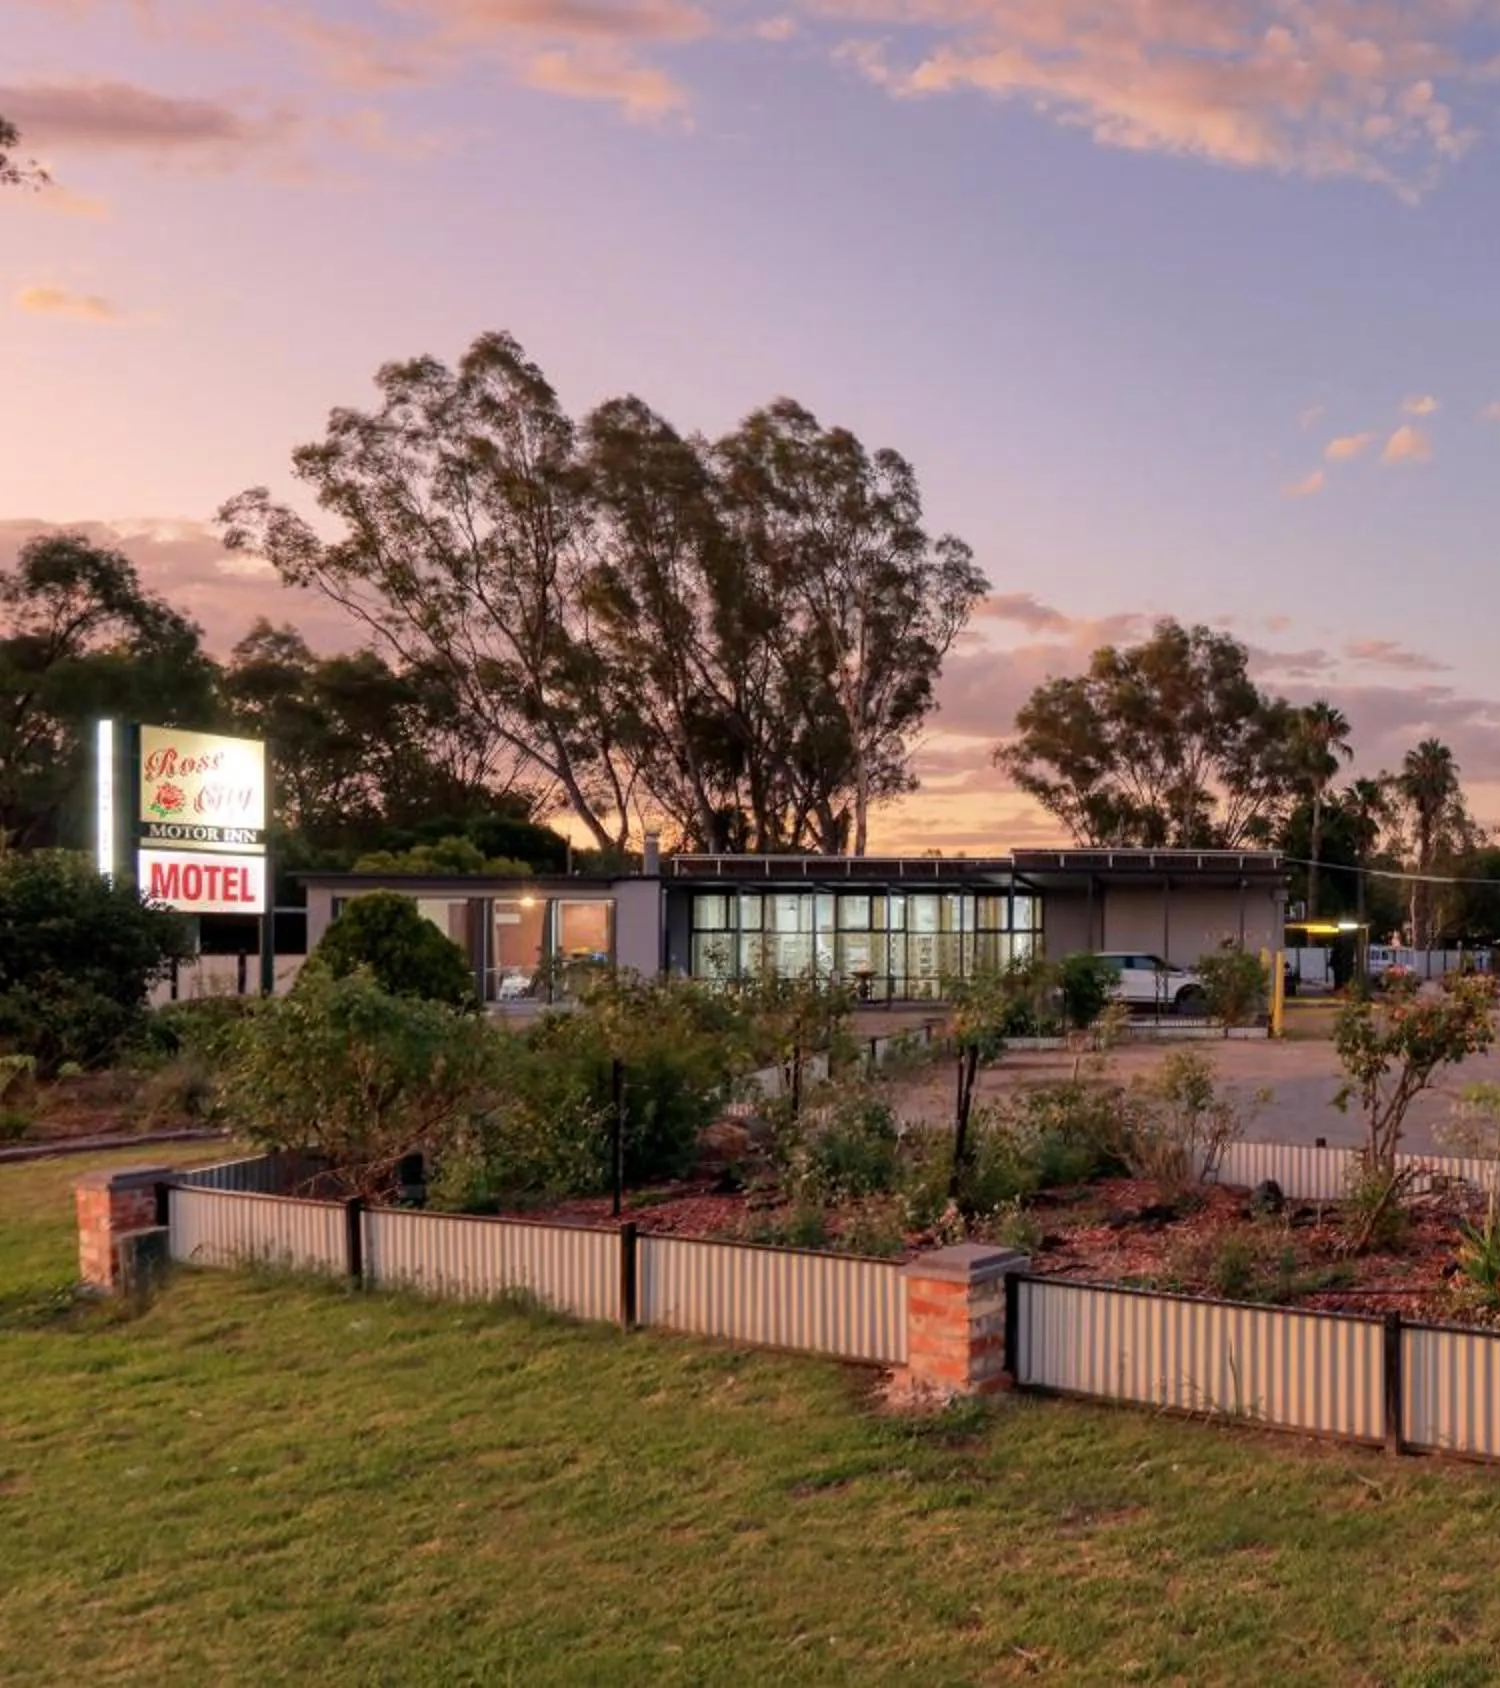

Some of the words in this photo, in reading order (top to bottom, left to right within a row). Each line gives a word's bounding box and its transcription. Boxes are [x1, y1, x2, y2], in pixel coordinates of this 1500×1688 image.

[144, 747, 224, 782] Rose
[149, 825, 218, 842] MOTOR
[224, 828, 257, 844] INN
[151, 863, 256, 902] MOTEL
